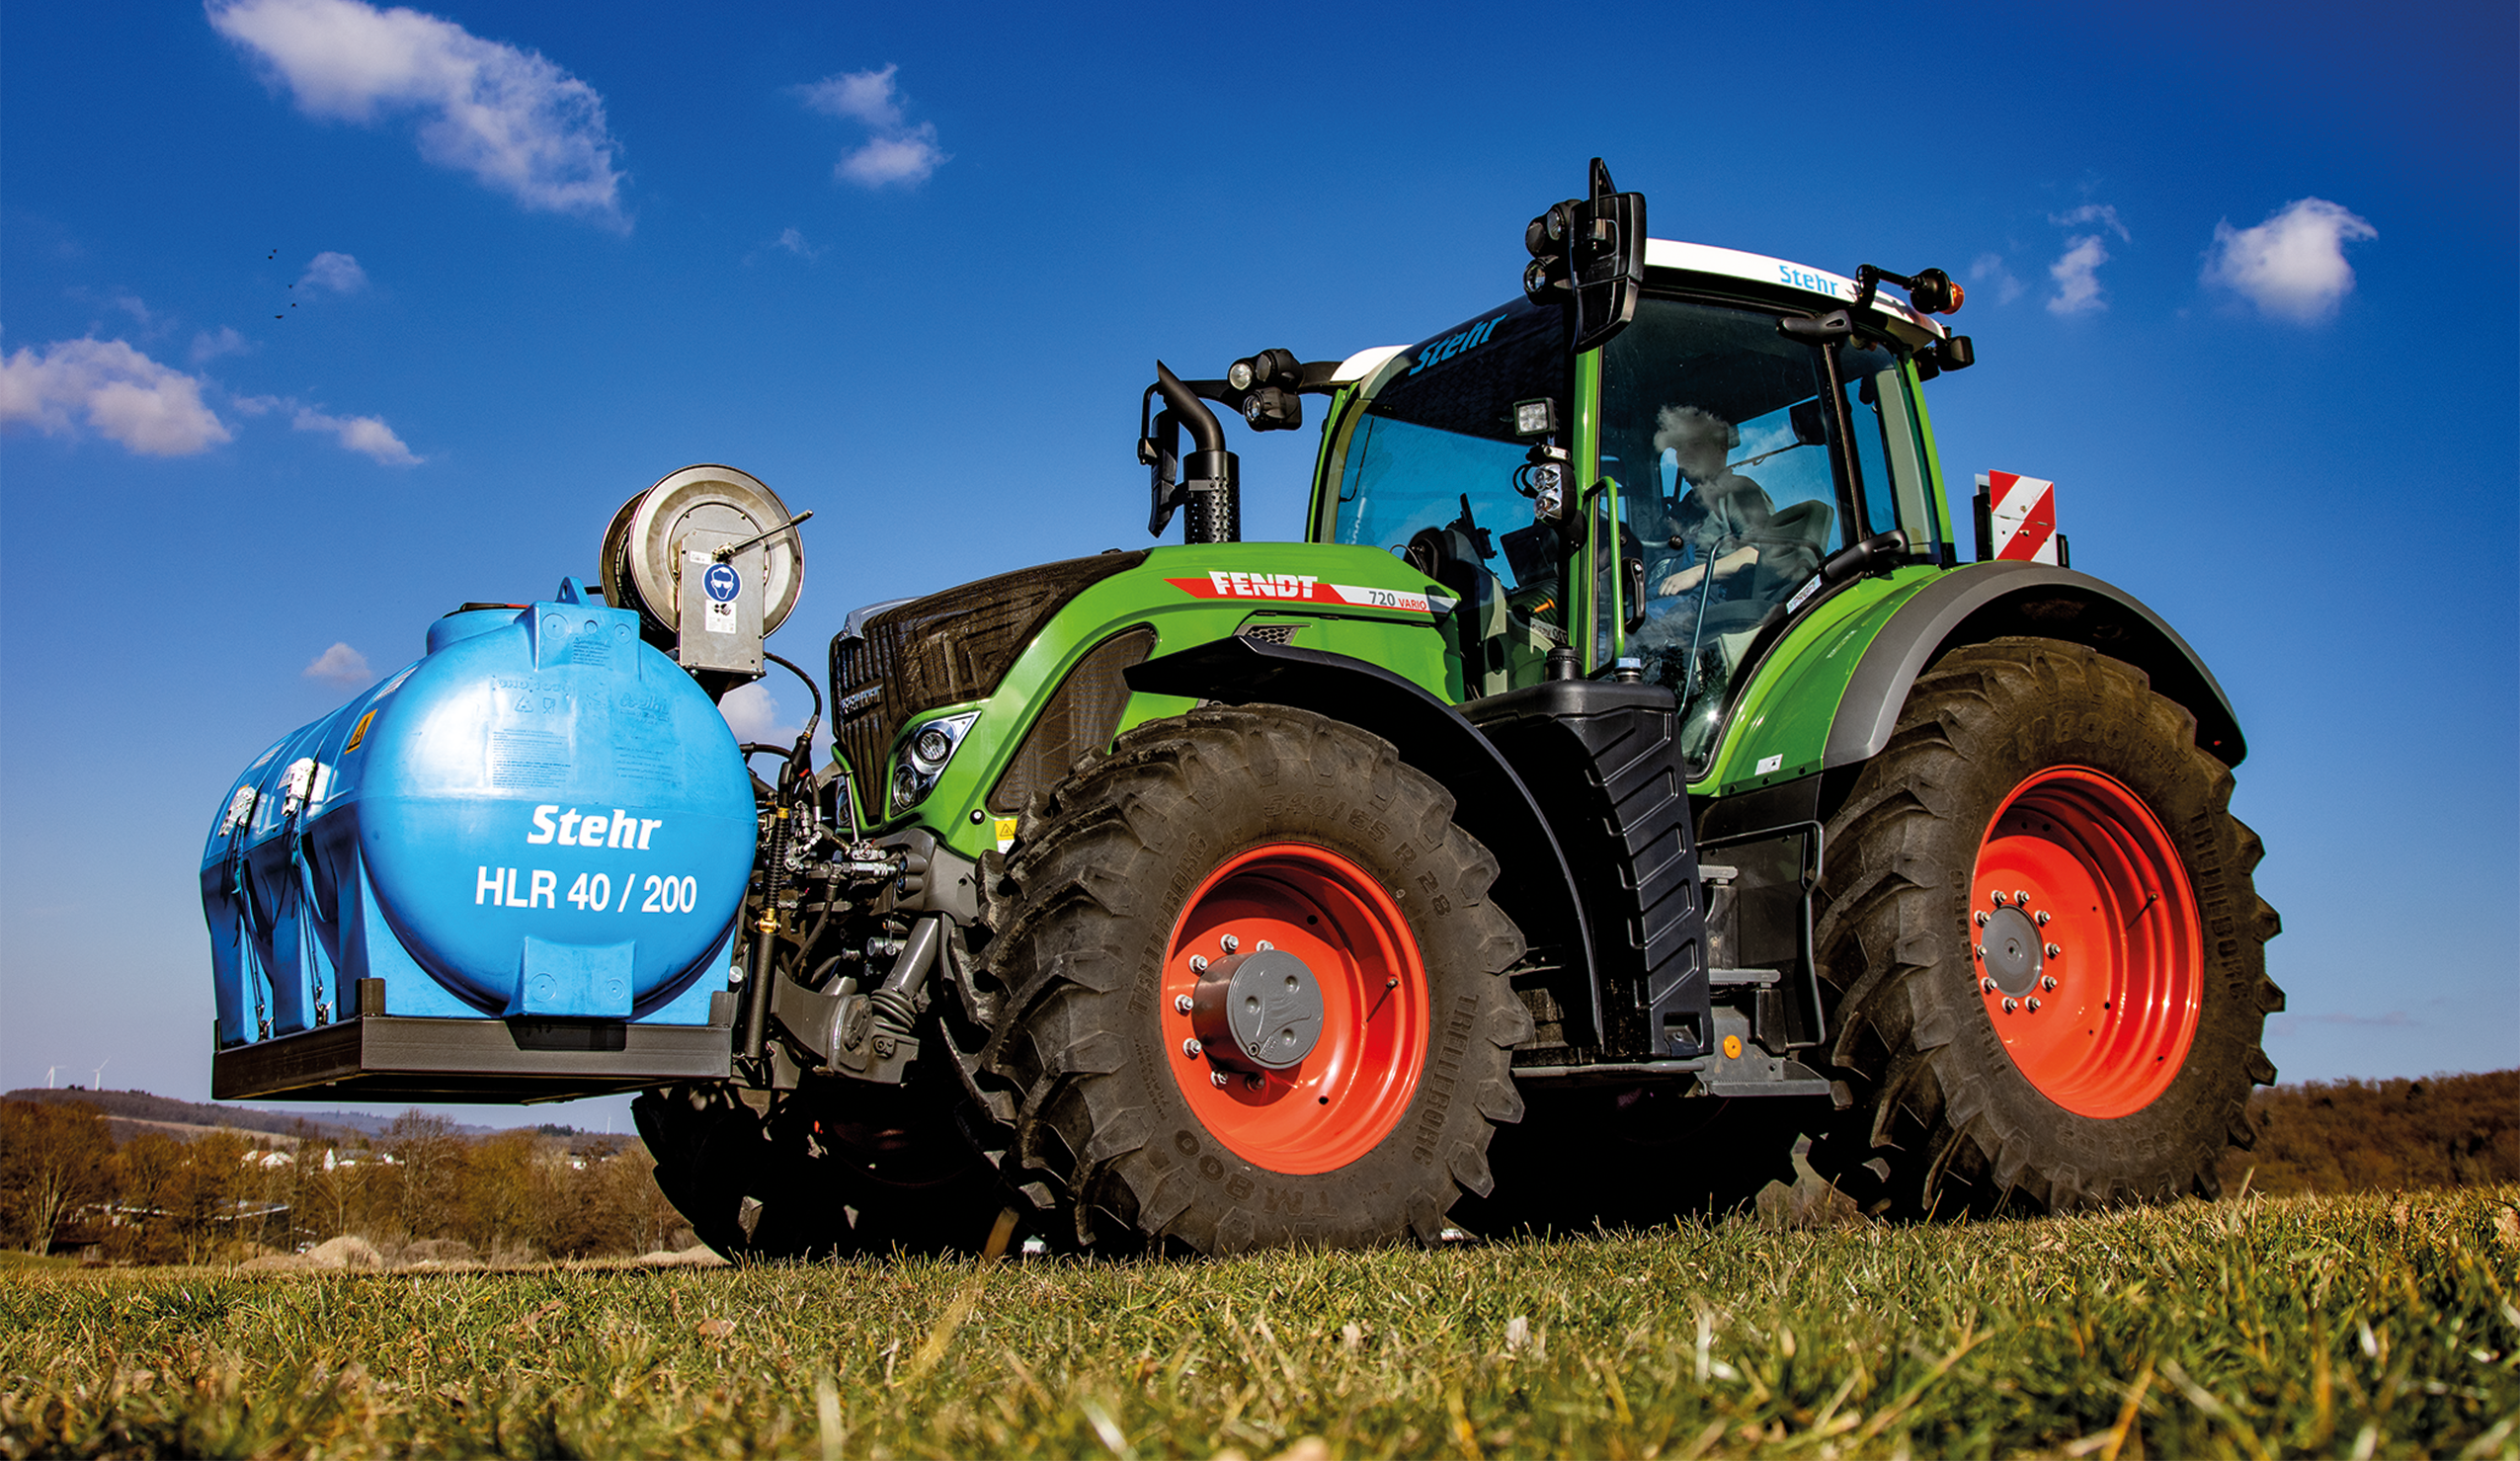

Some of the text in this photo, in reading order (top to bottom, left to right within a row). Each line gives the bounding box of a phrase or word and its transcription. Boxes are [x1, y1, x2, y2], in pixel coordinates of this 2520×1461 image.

[1779, 265, 1838, 296] Stehr
[1409, 314, 1507, 376] Stehr
[1208, 571, 1318, 599] FENDT
[1368, 591, 1427, 610] 720 VARIO
[527, 804, 663, 851] Stehr
[1263, 792, 1392, 844] 540/65
[1392, 842, 1418, 870] R
[1415, 870, 1452, 919] 28
[475, 865, 697, 914] HLR 40 / 200
[2190, 804, 2249, 1000] TRELLEBORG
[1411, 994, 1480, 1168] TRELLEBORG
